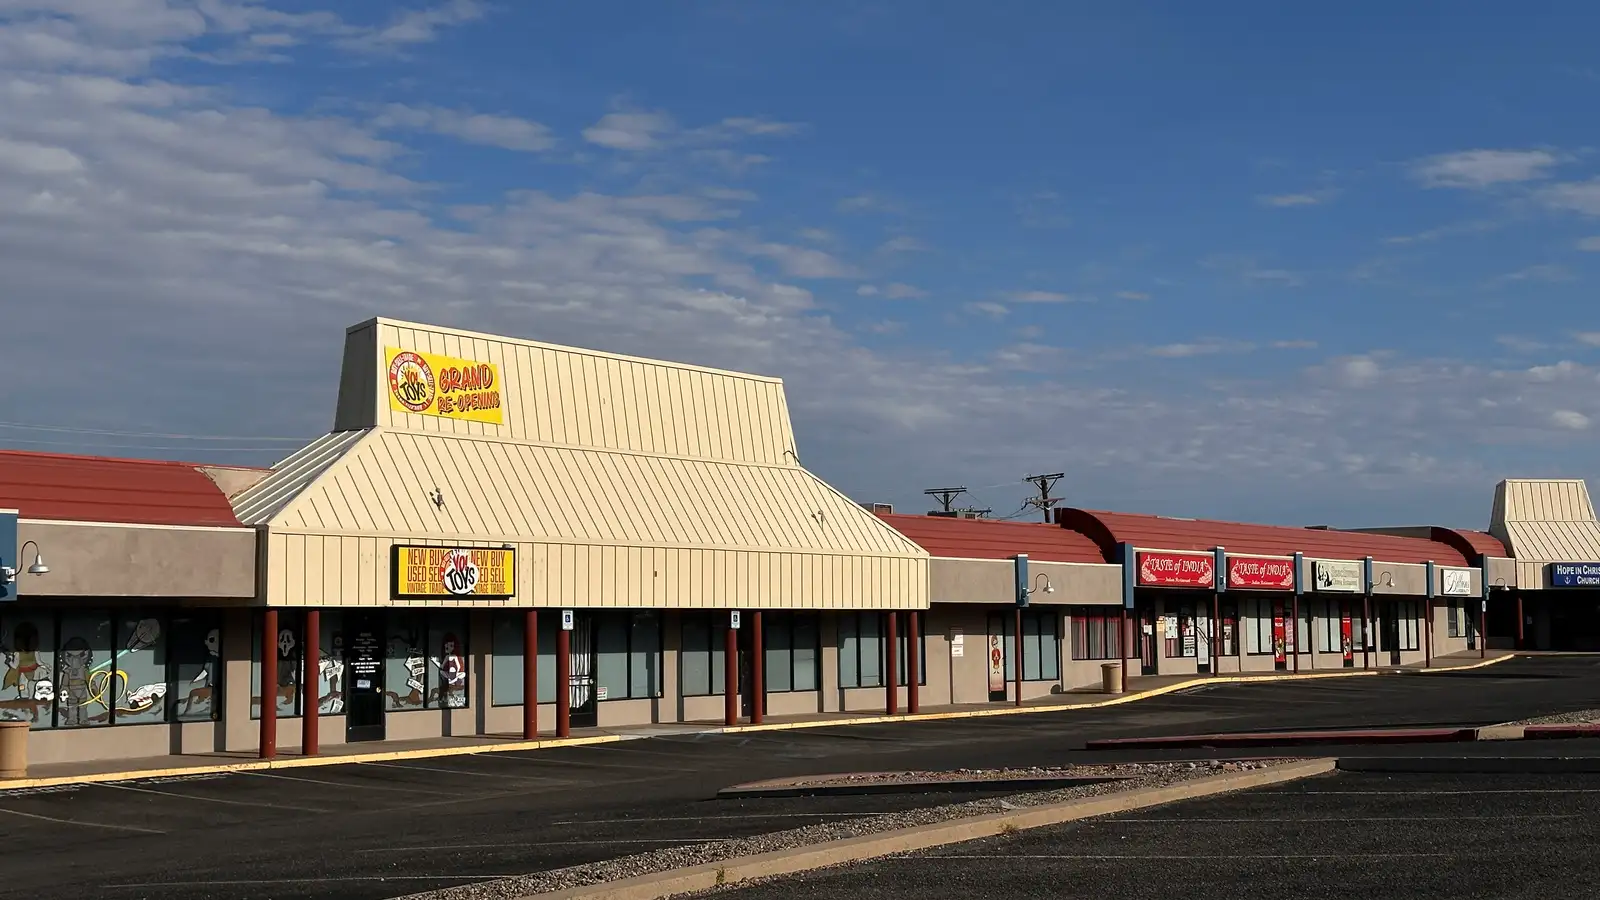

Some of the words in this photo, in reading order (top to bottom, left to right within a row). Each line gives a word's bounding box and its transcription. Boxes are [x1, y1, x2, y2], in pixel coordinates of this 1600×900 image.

[404, 369, 418, 386] YO!
[439, 364, 493, 393] GRAND
[400, 381, 426, 401] TOYS
[437, 391, 500, 414] RE-OPENING
[408, 549, 427, 565] NEW
[453, 554, 468, 572] YO!
[471, 551, 488, 567] NEW
[491, 551, 505, 567] BUY
[408, 566, 427, 582] USED
[429, 567, 443, 582] SEL
[1150, 558, 1173, 571] TASTE
[1174, 559, 1182, 575] of
[1182, 560, 1204, 573] INDIA
[1239, 562, 1259, 575] TASTE
[1260, 562, 1267, 578] of
[1267, 564, 1286, 576] INDIA
[1557, 565, 1574, 575] HOPE
[1575, 567, 1582, 575] IN
[446, 566, 475, 591] TOYS
[491, 568, 505, 583] SELL
[1577, 576, 1600, 584] CHURCH
[407, 583, 427, 593] VINTAGE
[491, 584, 505, 594] TRADE
